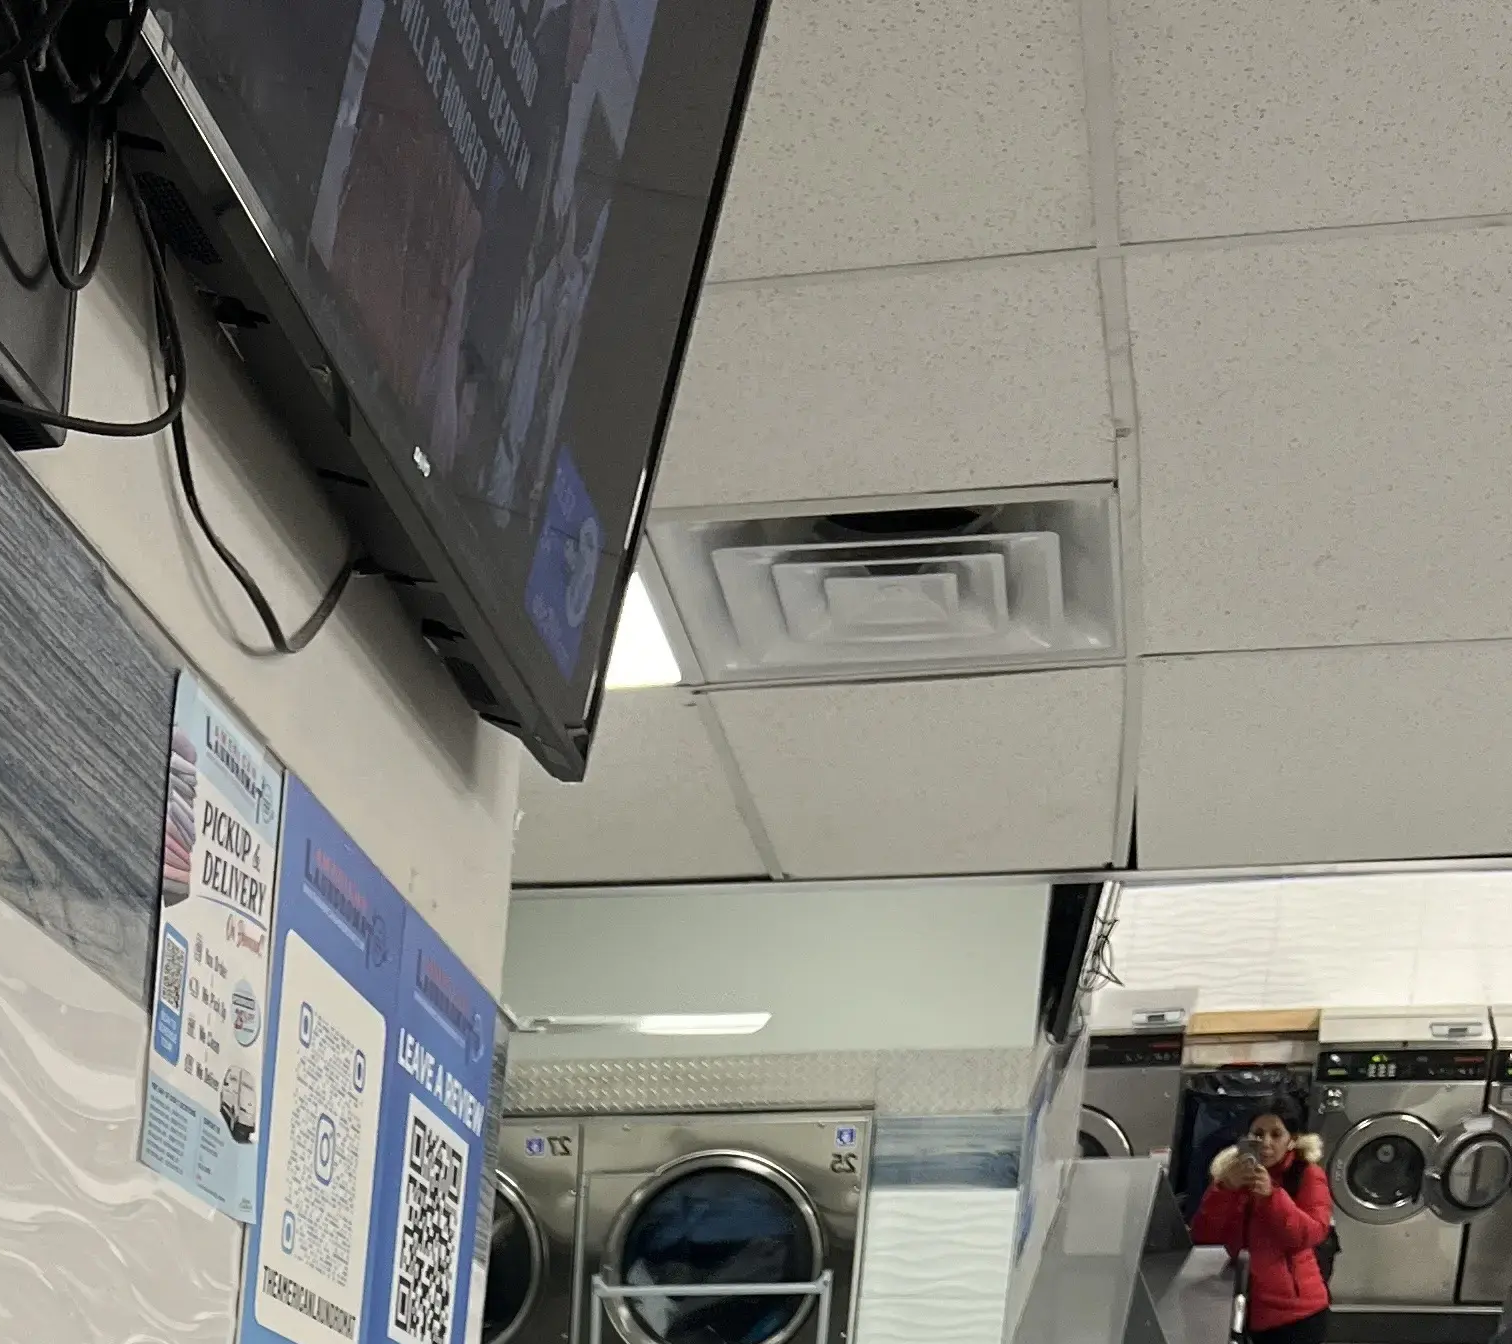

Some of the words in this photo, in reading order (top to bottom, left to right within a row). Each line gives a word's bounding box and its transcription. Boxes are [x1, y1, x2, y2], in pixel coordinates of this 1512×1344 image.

[426, 36, 447, 98] BE
[440, 67, 488, 191] HONORED
[510, 22, 539, 108] BOND
[476, 44, 494, 101] TO
[488, 74, 521, 168] DEATH
[514, 140, 531, 192] IN
[202, 800, 252, 863] PICKUP
[252, 843, 261, 874] &
[202, 850, 267, 917] DELIVERY
[398, 1027, 435, 1093] LEAVE
[434, 1064, 444, 1102] A
[443, 1071, 485, 1138] REVIEW
